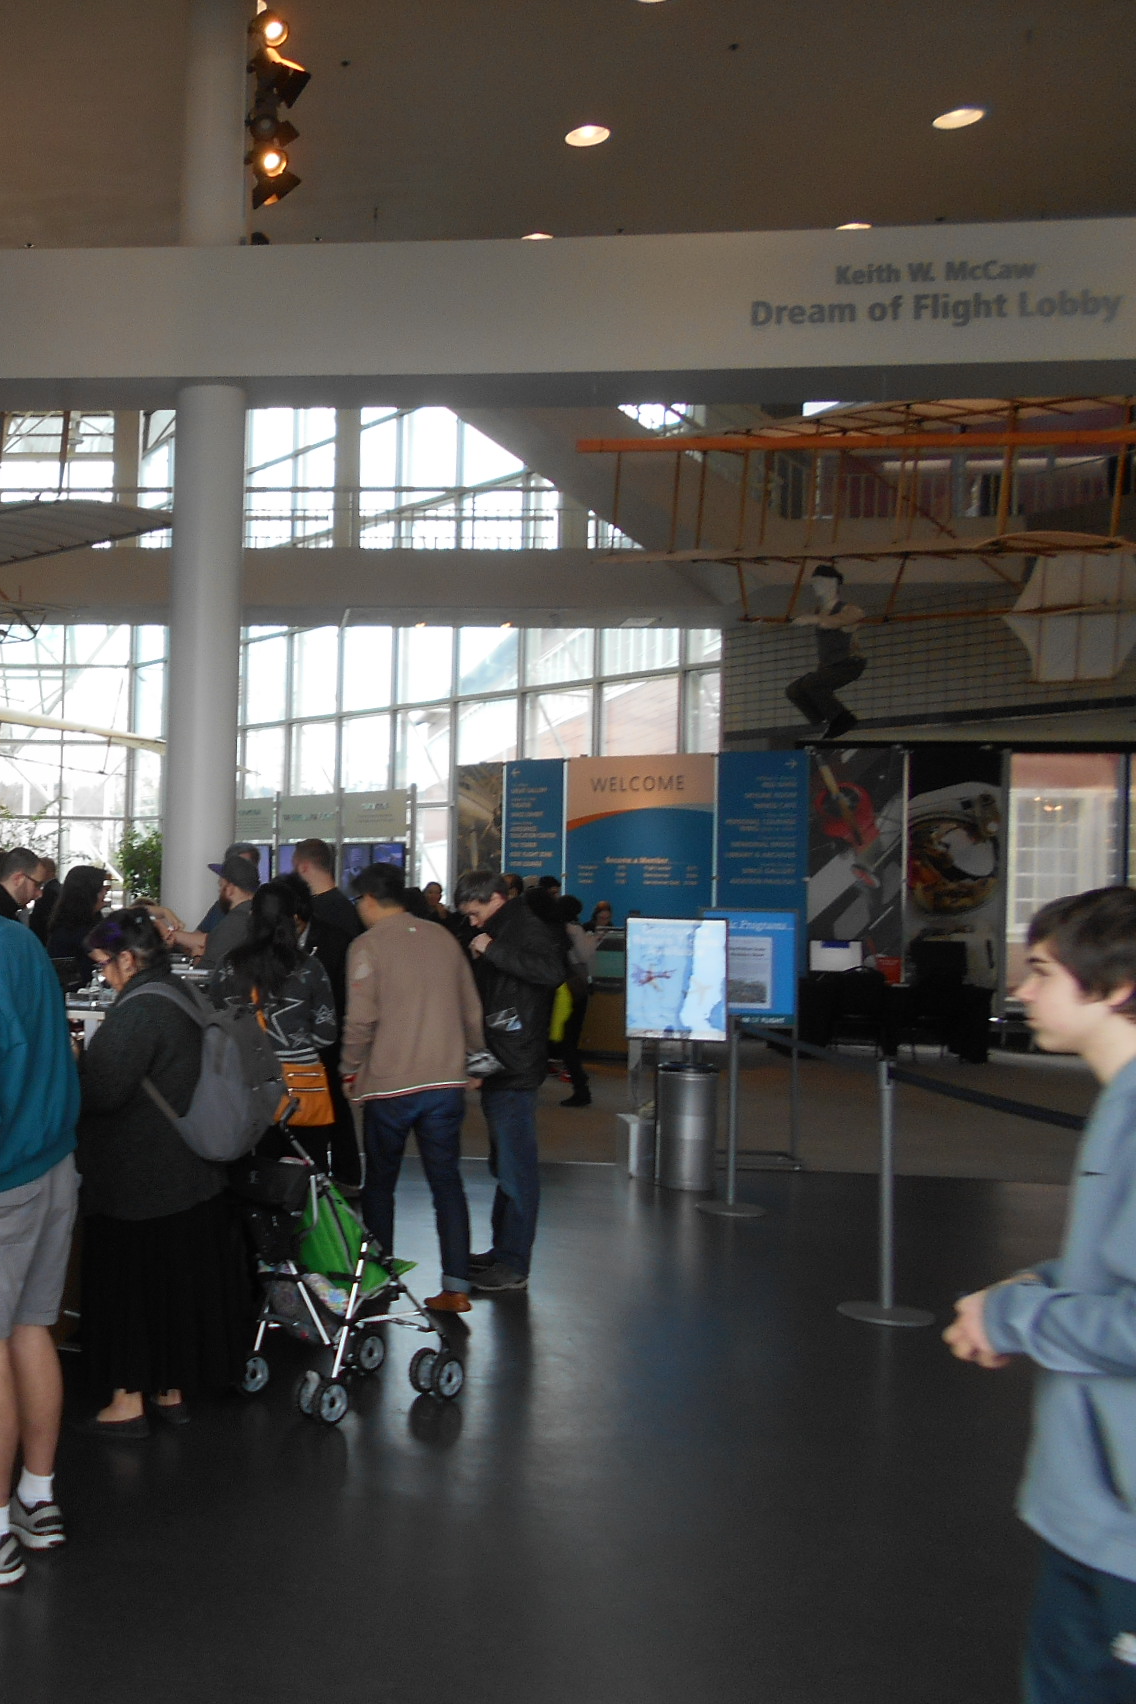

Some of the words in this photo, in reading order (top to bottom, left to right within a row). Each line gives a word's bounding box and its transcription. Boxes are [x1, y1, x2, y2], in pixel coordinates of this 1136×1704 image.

[835, 263, 900, 286] Keith
[908, 262, 935, 282] W.
[945, 259, 1038, 282] McCaw
[750, 300, 856, 326] Dream
[868, 296, 900, 322] of
[913, 292, 1007, 327] Flight
[1018, 290, 1123, 323] Lobby
[591, 774, 685, 794] WELCOME
